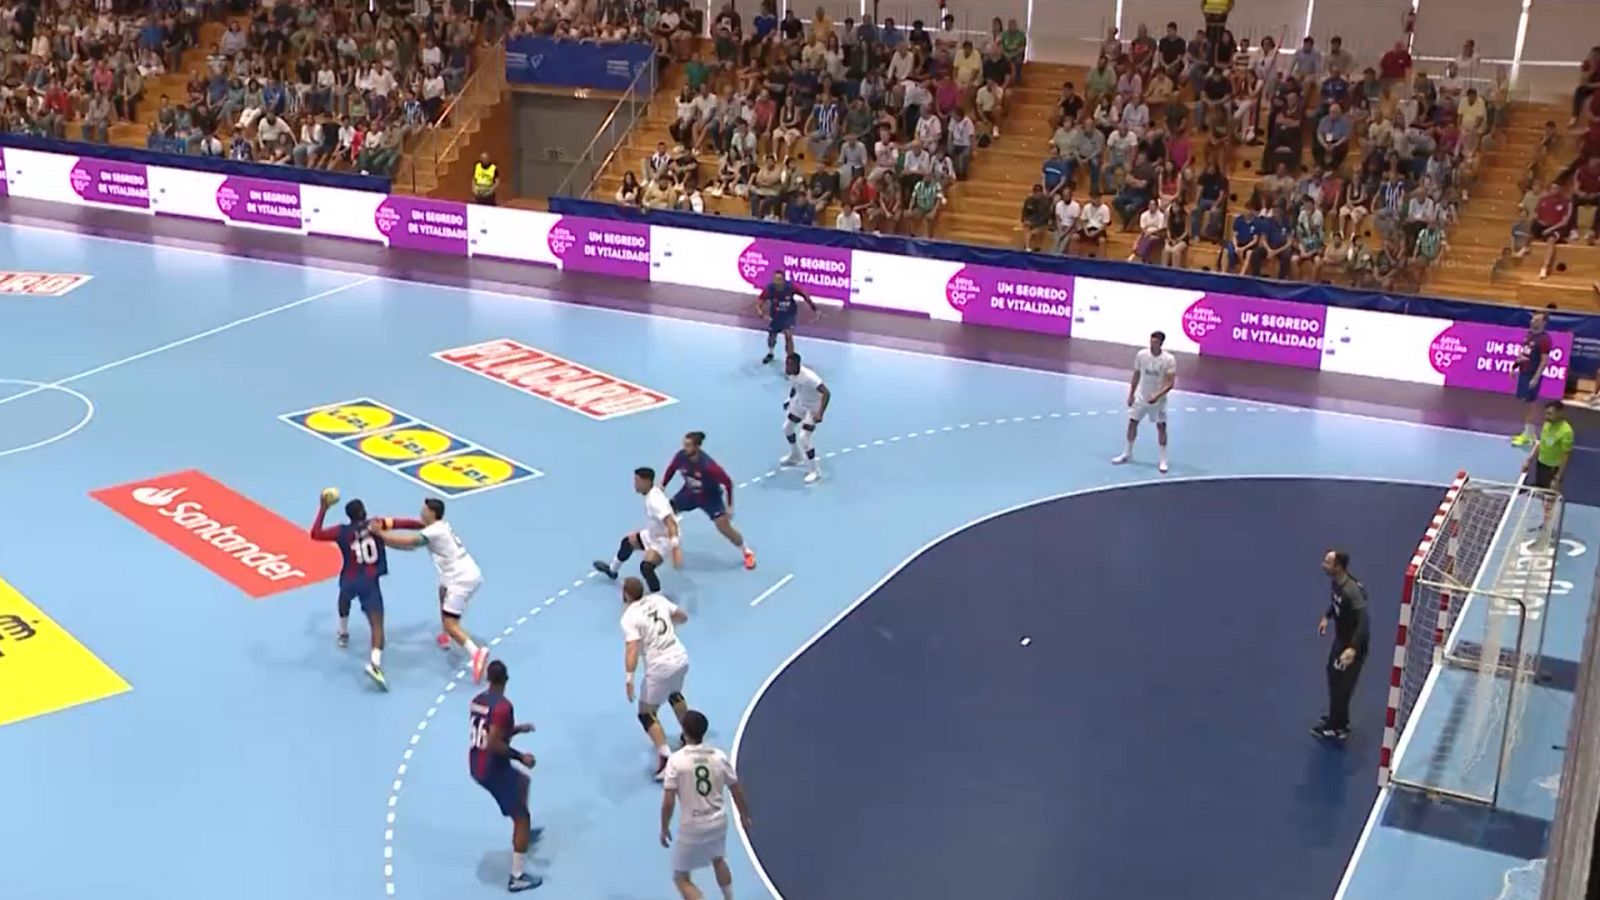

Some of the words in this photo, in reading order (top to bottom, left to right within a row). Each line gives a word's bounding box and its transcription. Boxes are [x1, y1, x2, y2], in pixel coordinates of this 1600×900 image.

[604, 232, 645, 248] SEGREDO
[584, 244, 595, 257] DE
[597, 246, 650, 263] VITALIDADE
[783, 255, 798, 267] UM
[800, 256, 846, 274] SEGREDO
[792, 270, 849, 289] VITALIDADE
[997, 281, 1014, 295] UM
[1015, 284, 1067, 302] SEGREDO
[990, 296, 1005, 310] DE
[1006, 298, 1072, 318] VITALIDADE
[1240, 311, 1260, 326] UM
[1261, 313, 1320, 333] SEGREDO
[1232, 327, 1249, 341] DE
[1486, 340, 1504, 355] UM
[1477, 356, 1493, 371] DE
[157, 500, 306, 581] Santander
[350, 537, 378, 564] 10
[695, 765, 712, 797] 8
